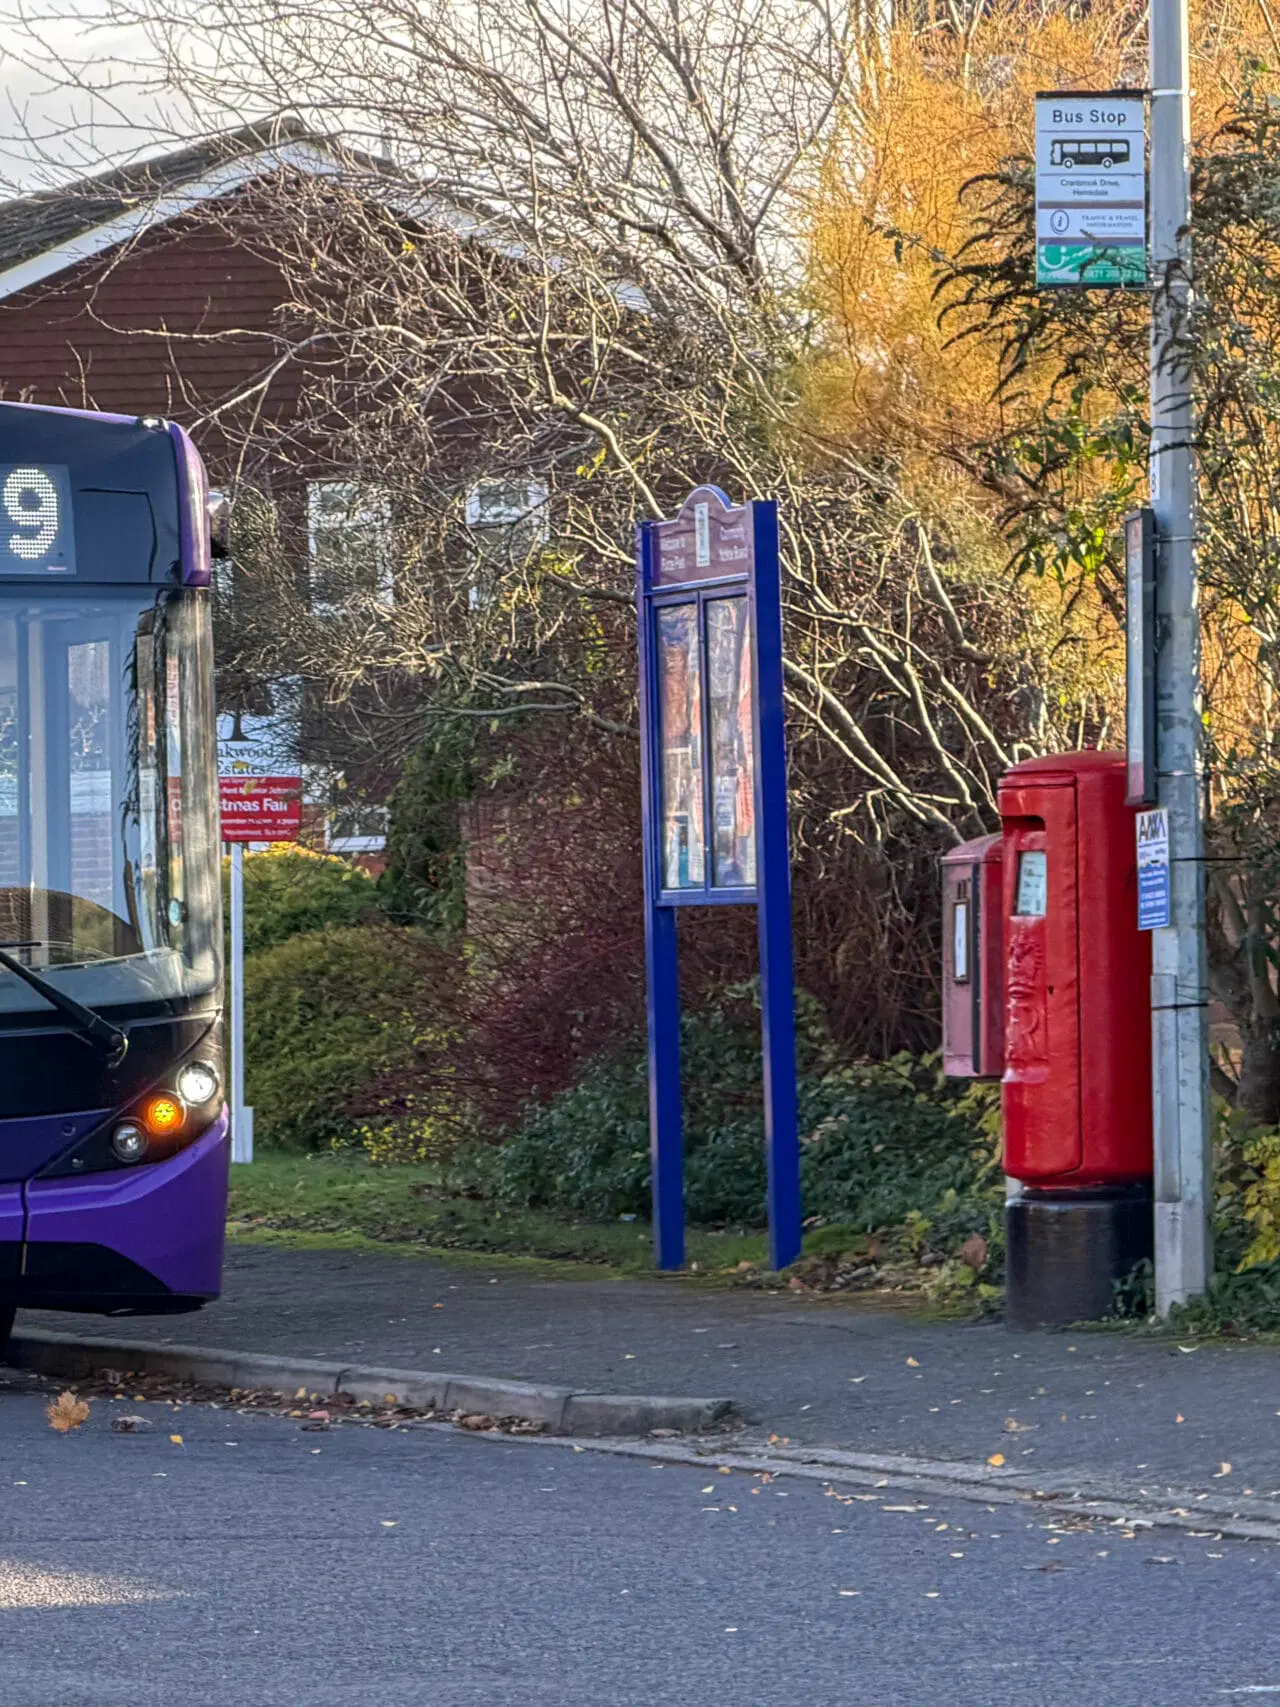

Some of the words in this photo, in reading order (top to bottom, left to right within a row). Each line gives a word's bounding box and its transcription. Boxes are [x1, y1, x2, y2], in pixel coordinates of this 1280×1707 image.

[1052, 109, 1084, 123] Bus
[1089, 109, 1127, 126] Stop
[2, 467, 60, 560] 9
